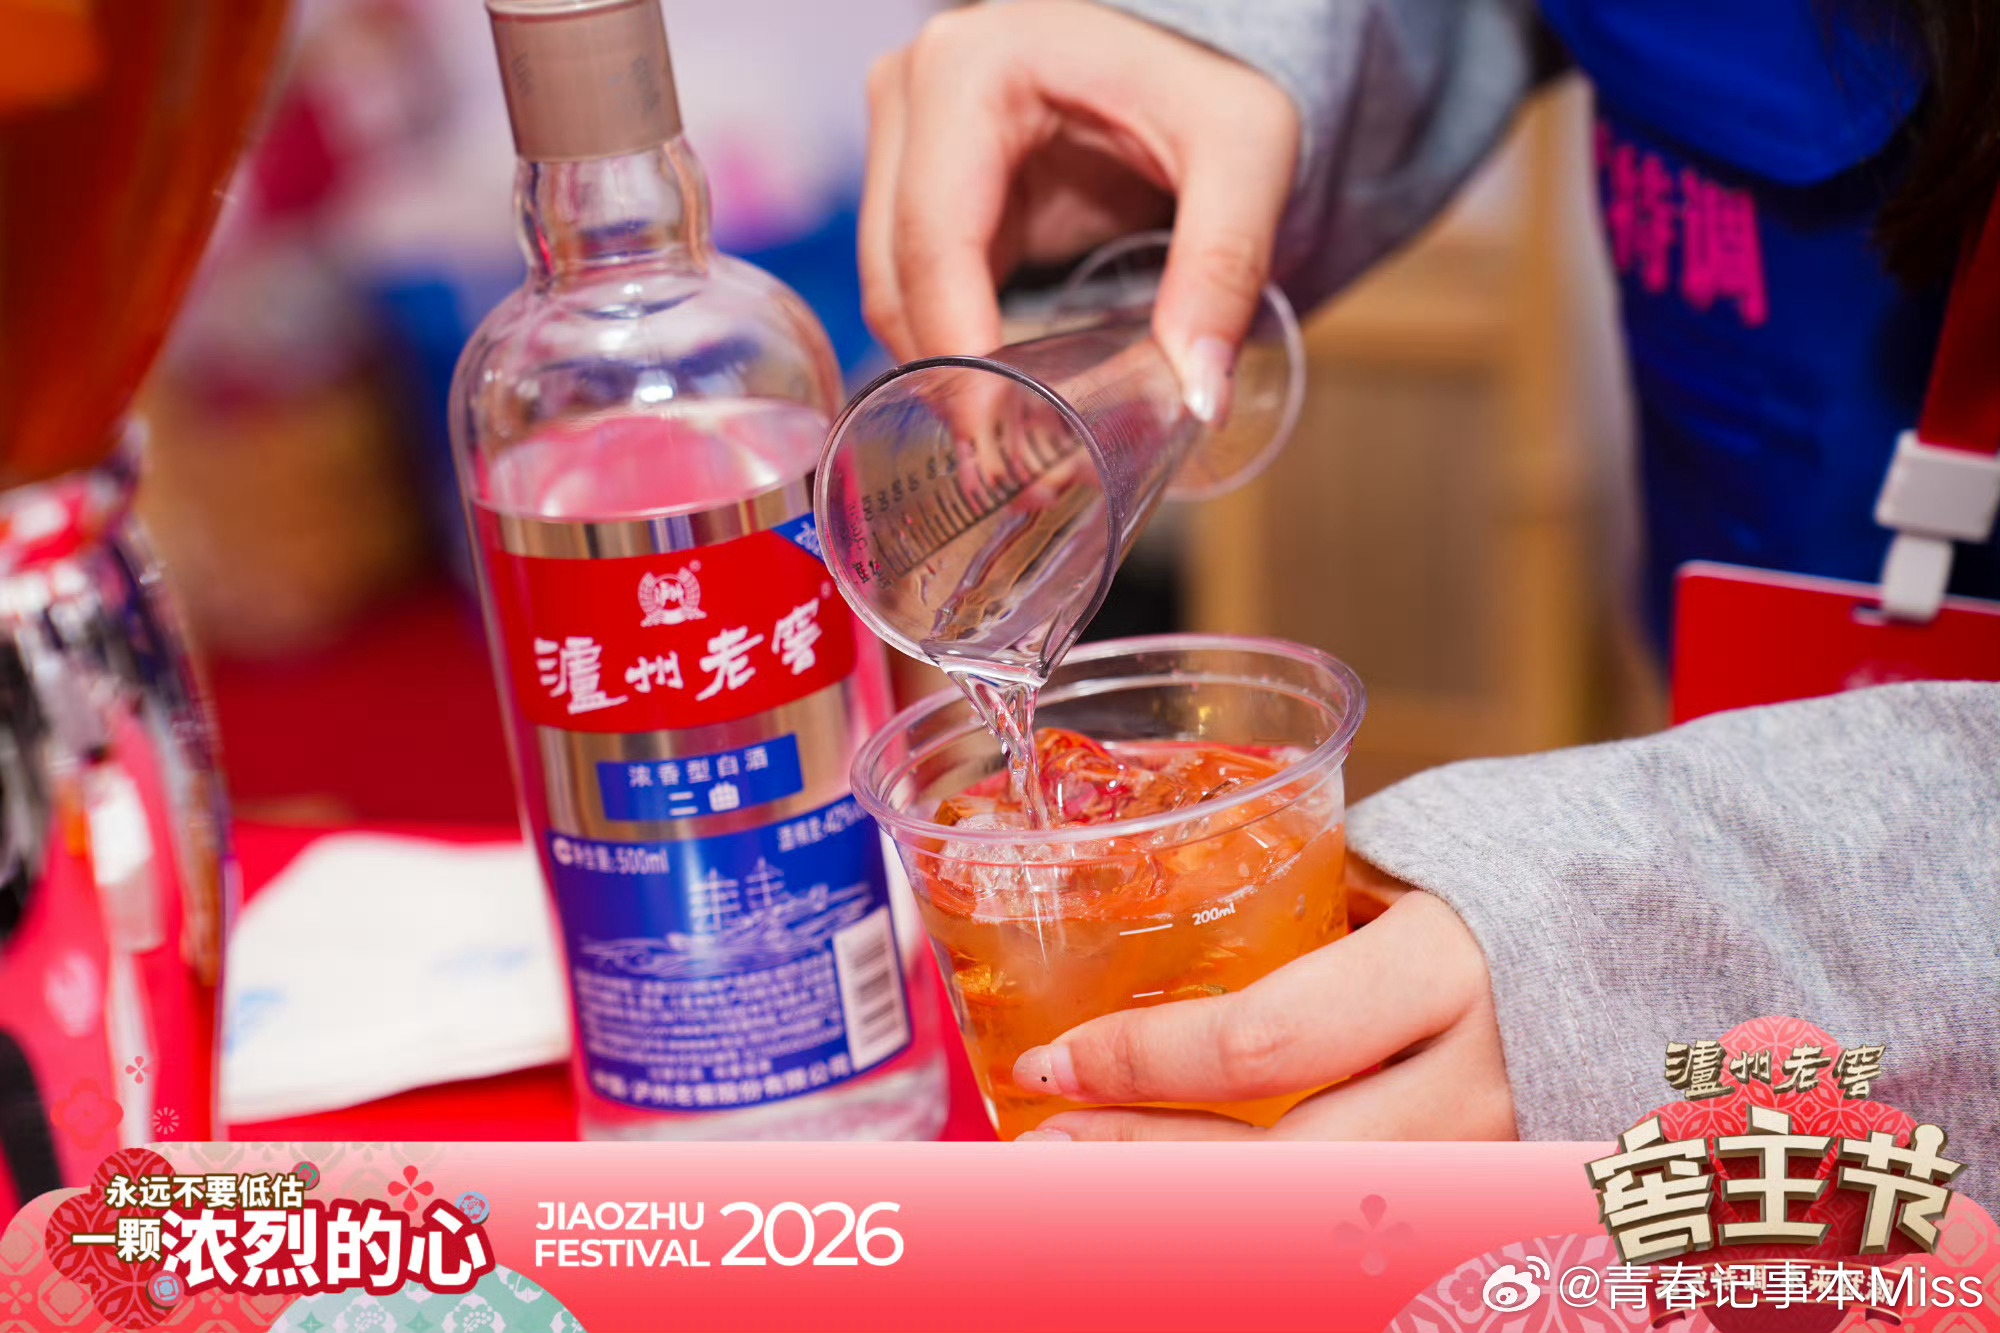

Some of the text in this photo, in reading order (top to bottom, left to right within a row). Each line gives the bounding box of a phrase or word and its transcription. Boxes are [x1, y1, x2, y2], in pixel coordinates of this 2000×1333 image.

[1597, 120, 1768, 328] 特调
[534, 598, 823, 714] 泸州老窖
[628, 746, 769, 788] 浓香型白酒
[669, 783, 741, 817] 二曲
[1192, 902, 1237, 926] 200ml
